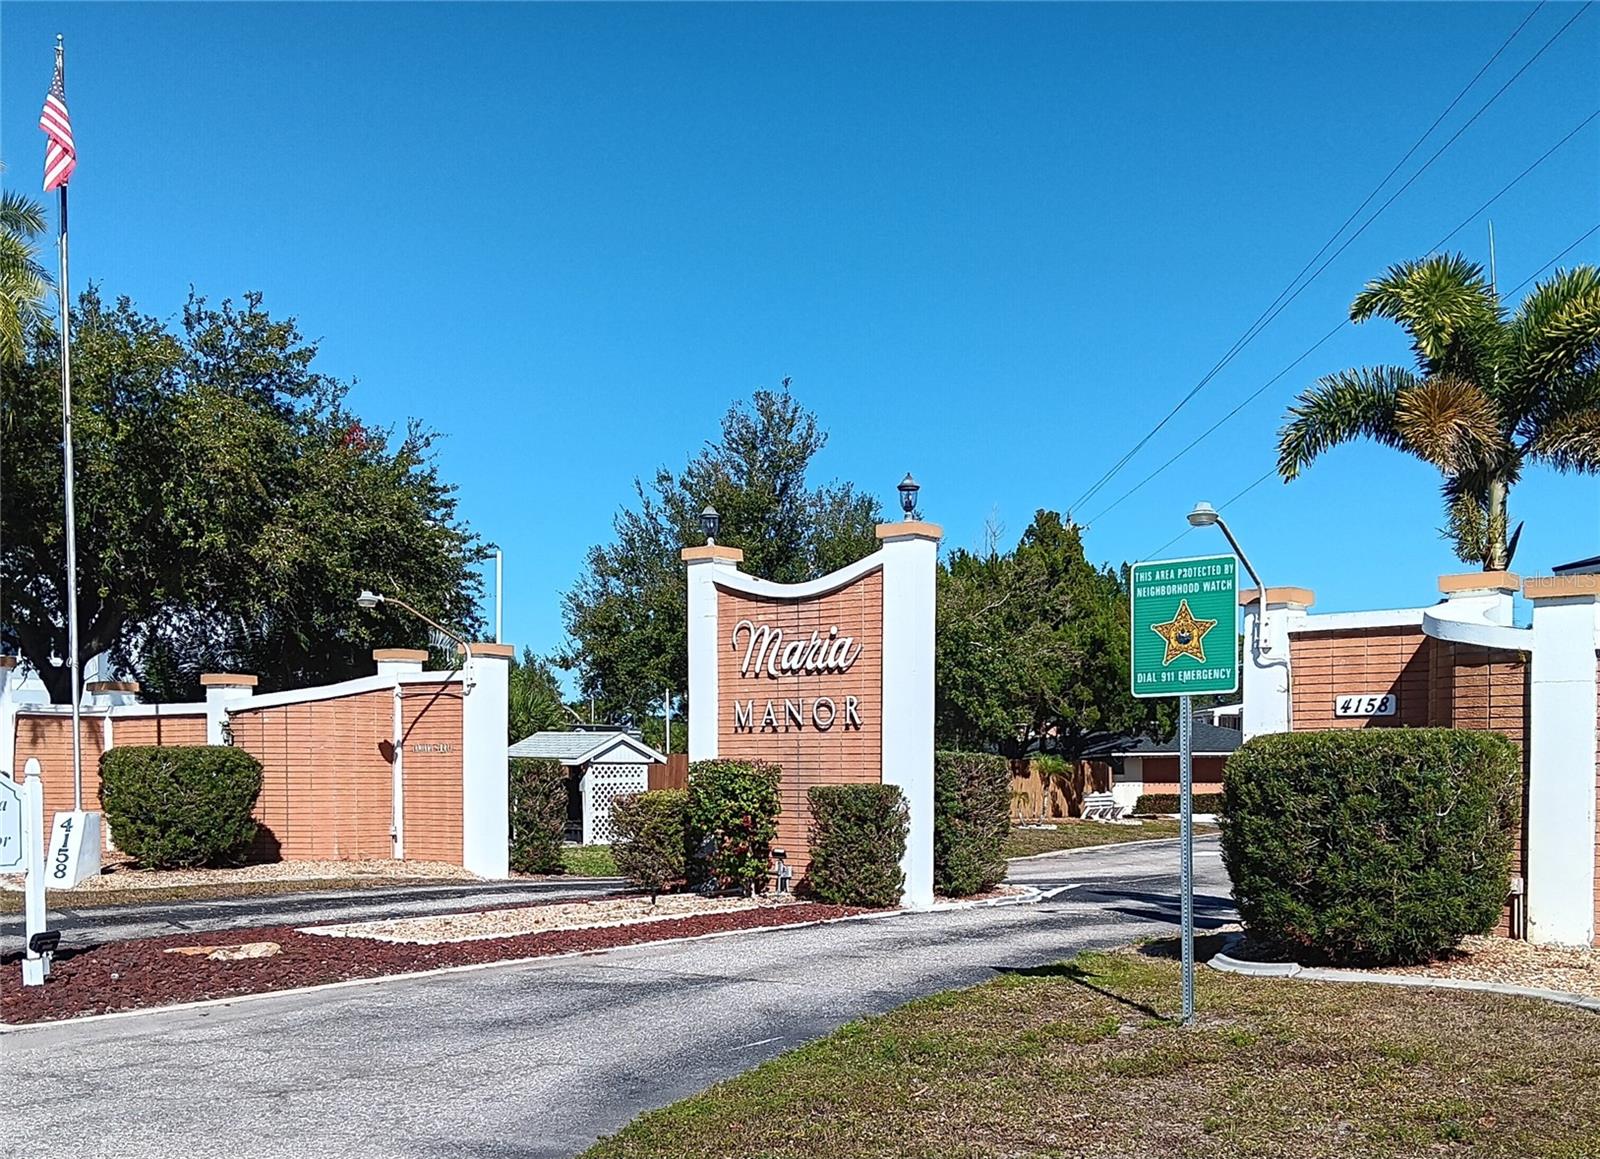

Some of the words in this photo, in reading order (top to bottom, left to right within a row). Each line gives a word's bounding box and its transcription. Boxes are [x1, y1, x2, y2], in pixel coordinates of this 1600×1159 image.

[1135, 572, 1152, 582] THIS
[1155, 569, 1174, 580] AREA
[1177, 565, 1221, 578] PROTECTED
[1224, 564, 1234, 574] BY
[1136, 583, 1199, 597] NEIGHBORHOOD
[1203, 580, 1232, 592] WATCH
[732, 620, 864, 678] Maria
[1137, 672, 1157, 683] DIAL
[1161, 671, 1175, 682] 911
[1178, 668, 1231, 681] EMERGENCY
[1340, 696, 1390, 714] 4158
[734, 695, 864, 734] MANOR
[54, 818, 73, 878] 4158
